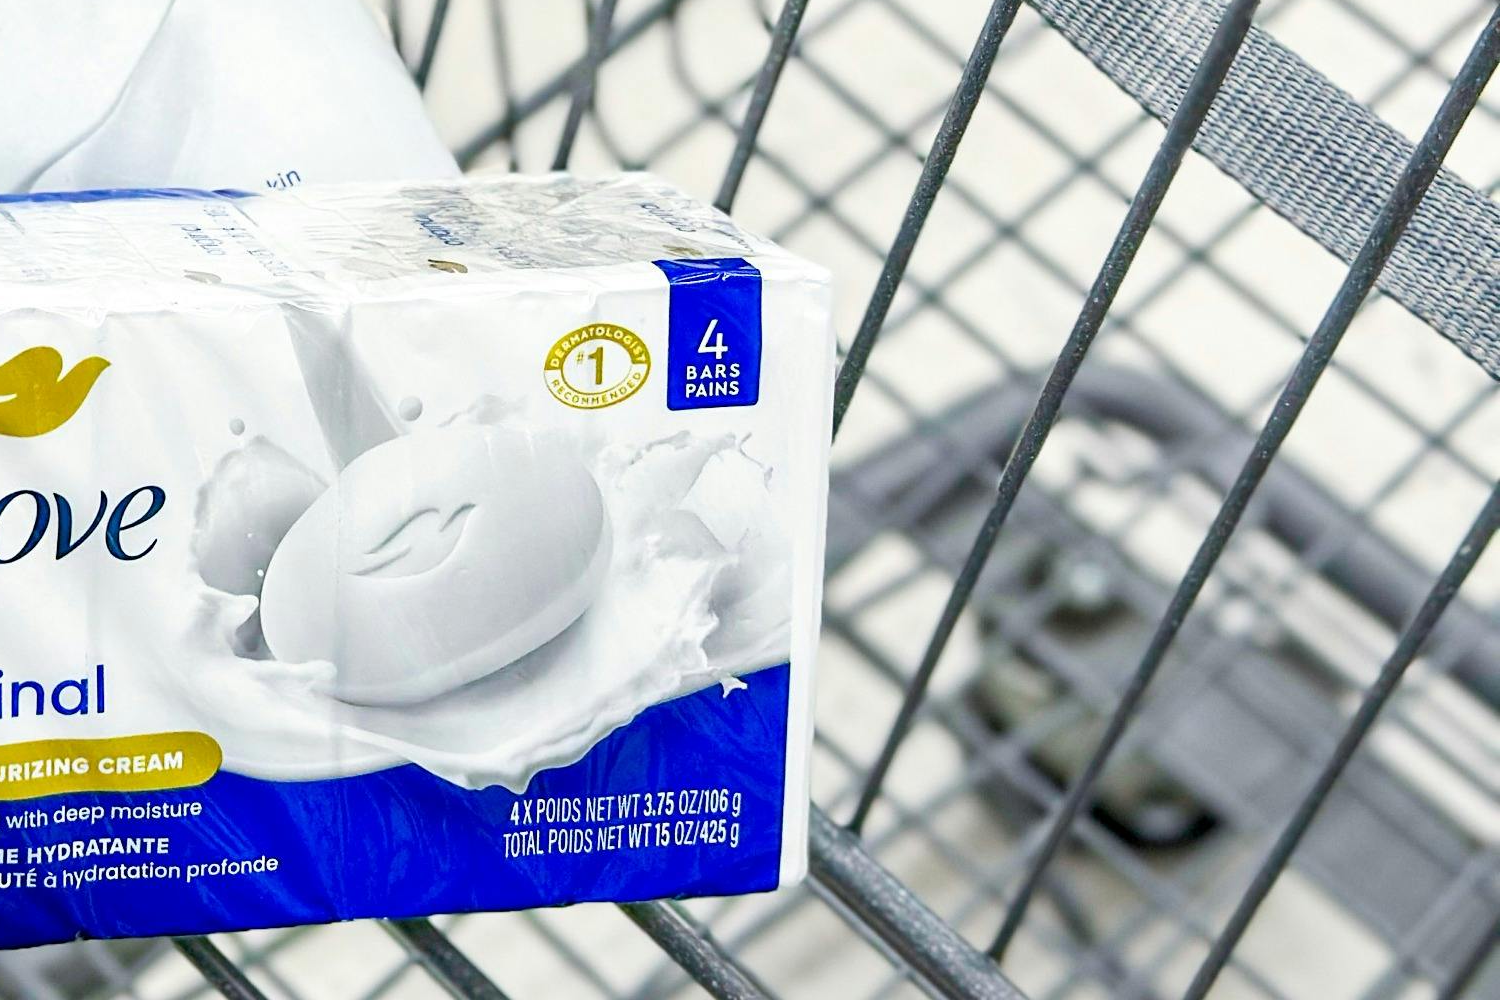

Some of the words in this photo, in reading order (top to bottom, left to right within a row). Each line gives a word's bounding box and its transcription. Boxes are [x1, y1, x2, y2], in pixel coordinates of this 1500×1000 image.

[550, 326, 646, 368] DERMATOLOGIST
[698, 319, 729, 360] 4
[576, 346, 604, 386] #1
[686, 363, 741, 380] BARS
[552, 372, 641, 405] RECOMMENDED
[685, 381, 740, 399] PAINS
[98, 750, 184, 776] CREAM
[6, 811, 49, 830] with
[53, 804, 106, 829] deep
[110, 801, 203, 821] moisture
[510, 801, 520, 826] 4
[522, 799, 533, 825] X
[536, 797, 582, 824] POIDS
[585, 795, 615, 823] NET
[617, 793, 641, 819] WT
[643, 791, 675, 818] 3.75
[678, 788, 729, 815] OZ/106
[732, 792, 742, 818] g
[27, 837, 170, 865] HYDRATANTE
[503, 829, 544, 859] TOTAL
[548, 828, 593, 854] POIDS
[597, 824, 625, 852] NET
[628, 822, 653, 849] WT
[655, 822, 671, 847] 15
[674, 818, 727, 846] OZ/425
[730, 822, 740, 849] g
[44, 871, 58, 890] à
[62, 863, 181, 890] hydratation
[186, 855, 279, 879] profonde
